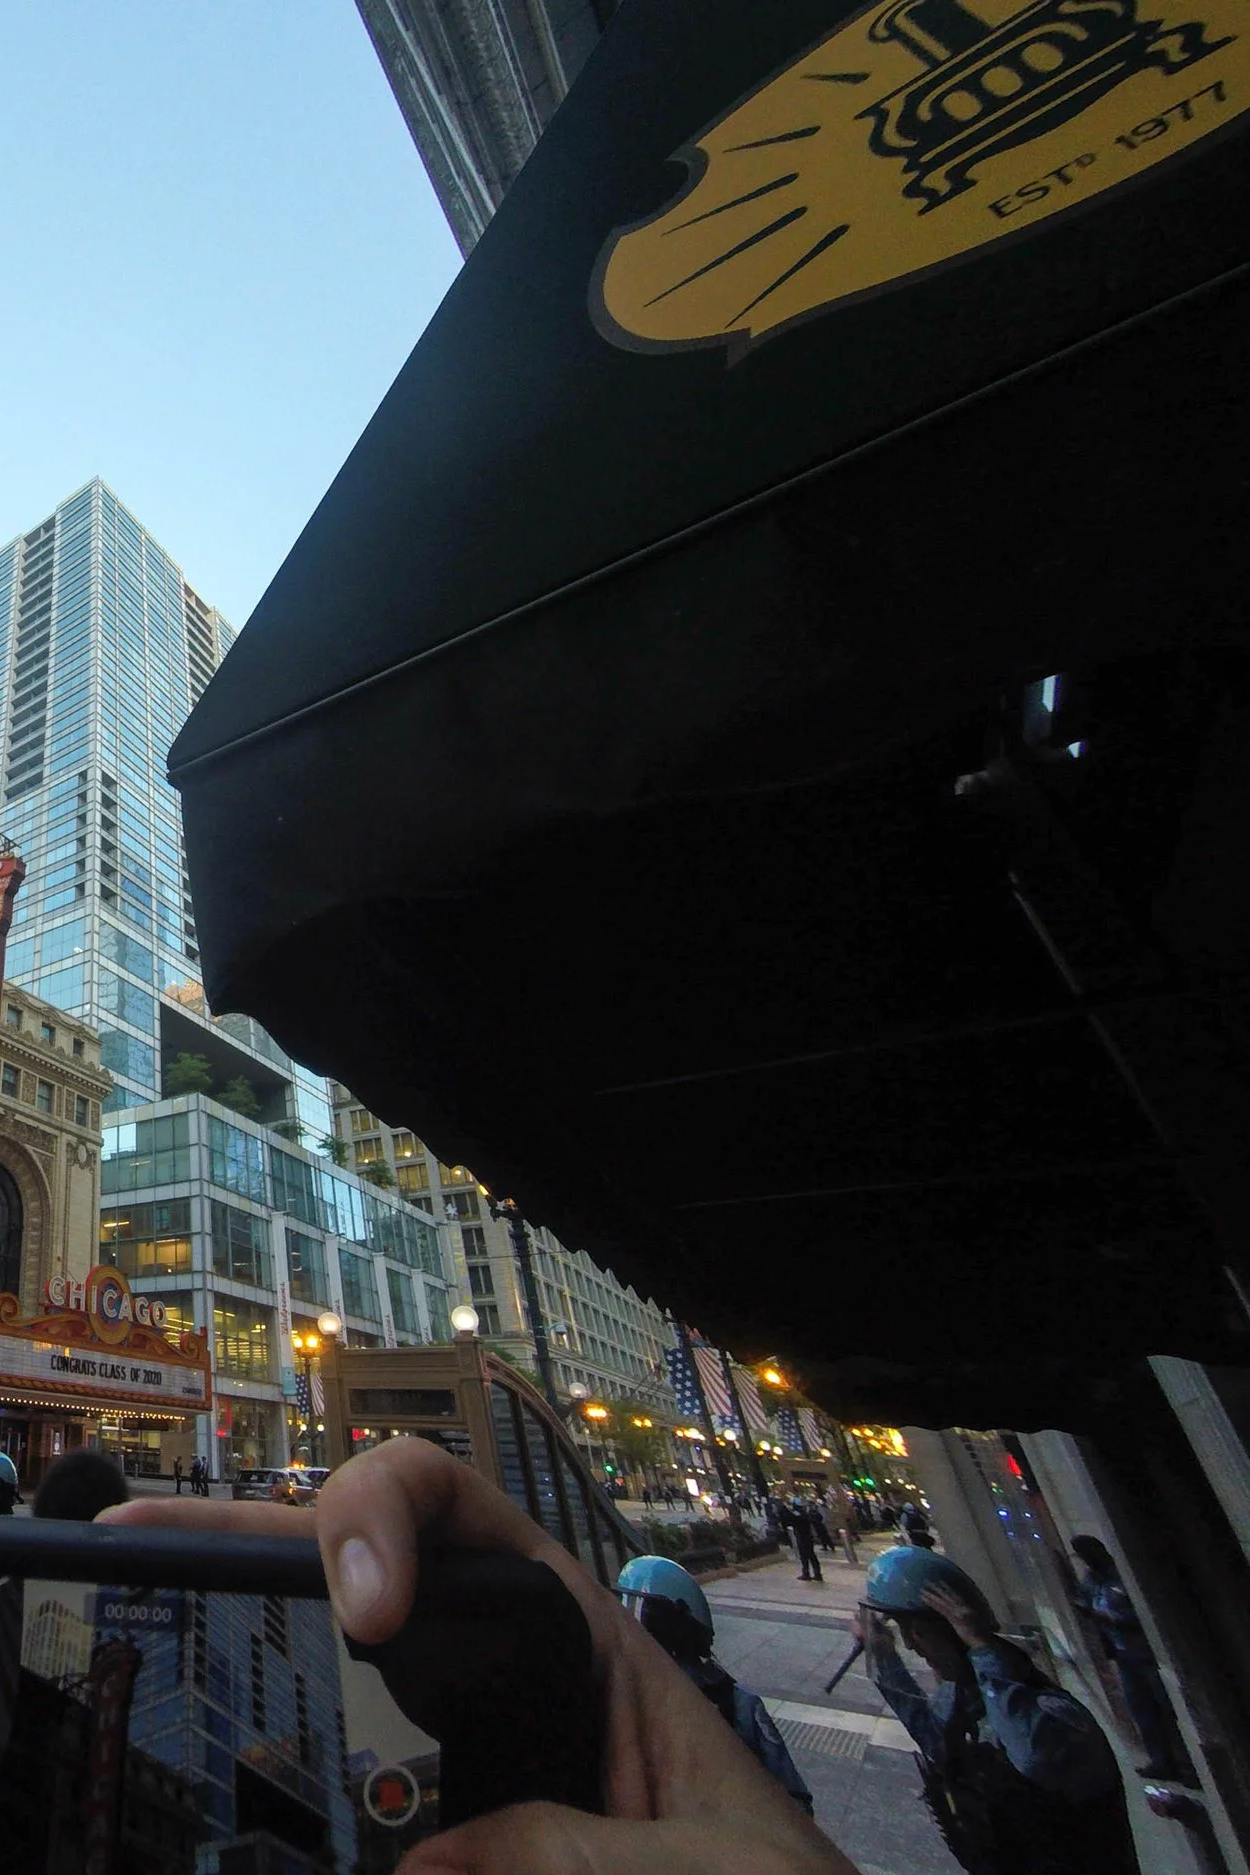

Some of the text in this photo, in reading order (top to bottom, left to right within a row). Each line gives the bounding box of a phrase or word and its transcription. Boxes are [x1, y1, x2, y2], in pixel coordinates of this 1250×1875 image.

[1114, 80, 1226, 150] 1977
[49, 1275, 167, 1328] CHICAGO
[50, 1354, 163, 1386] CONGRATS CLASS OF 2020
[104, 1602, 172, 1623] 00:00:00
